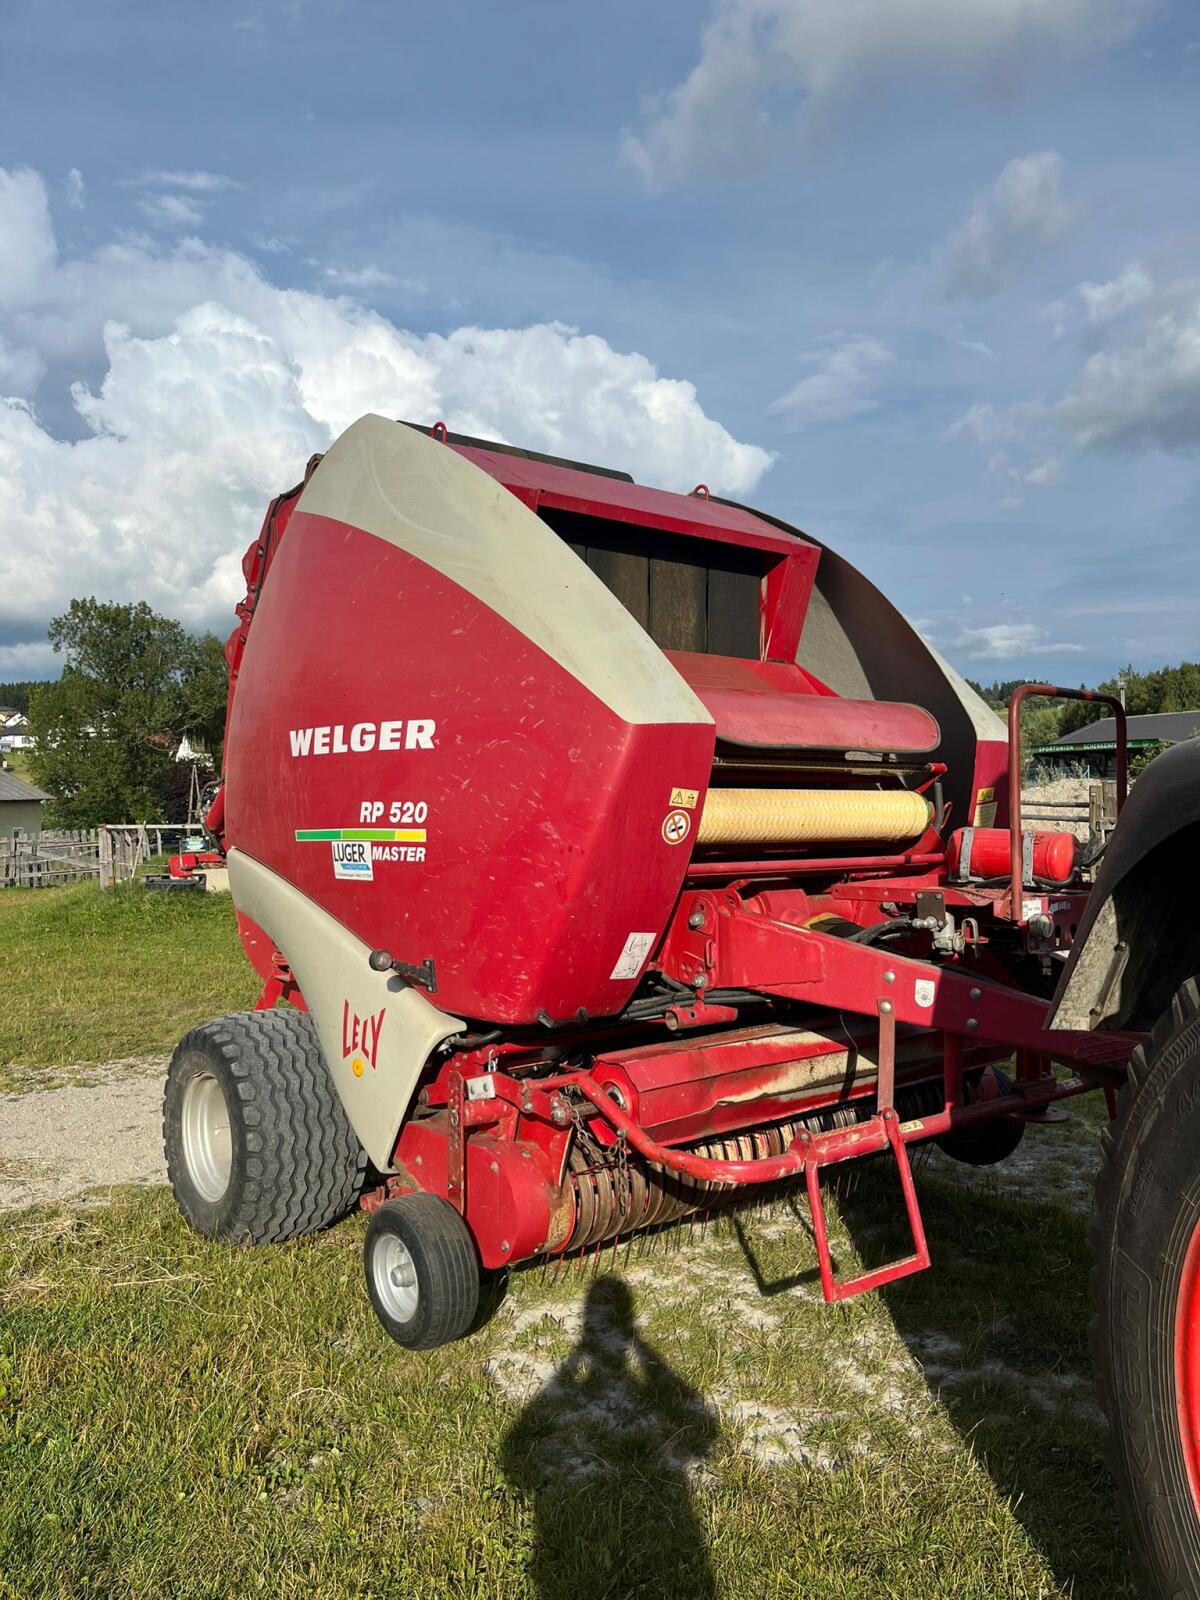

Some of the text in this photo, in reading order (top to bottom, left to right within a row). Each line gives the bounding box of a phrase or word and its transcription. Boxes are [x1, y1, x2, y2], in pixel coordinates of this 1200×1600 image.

[289, 718, 436, 757] WELGER
[360, 801, 428, 824] RP 520
[333, 842, 366, 863] LUGER
[372, 846, 426, 862] MASTER
[342, 998, 386, 1070] LELY
